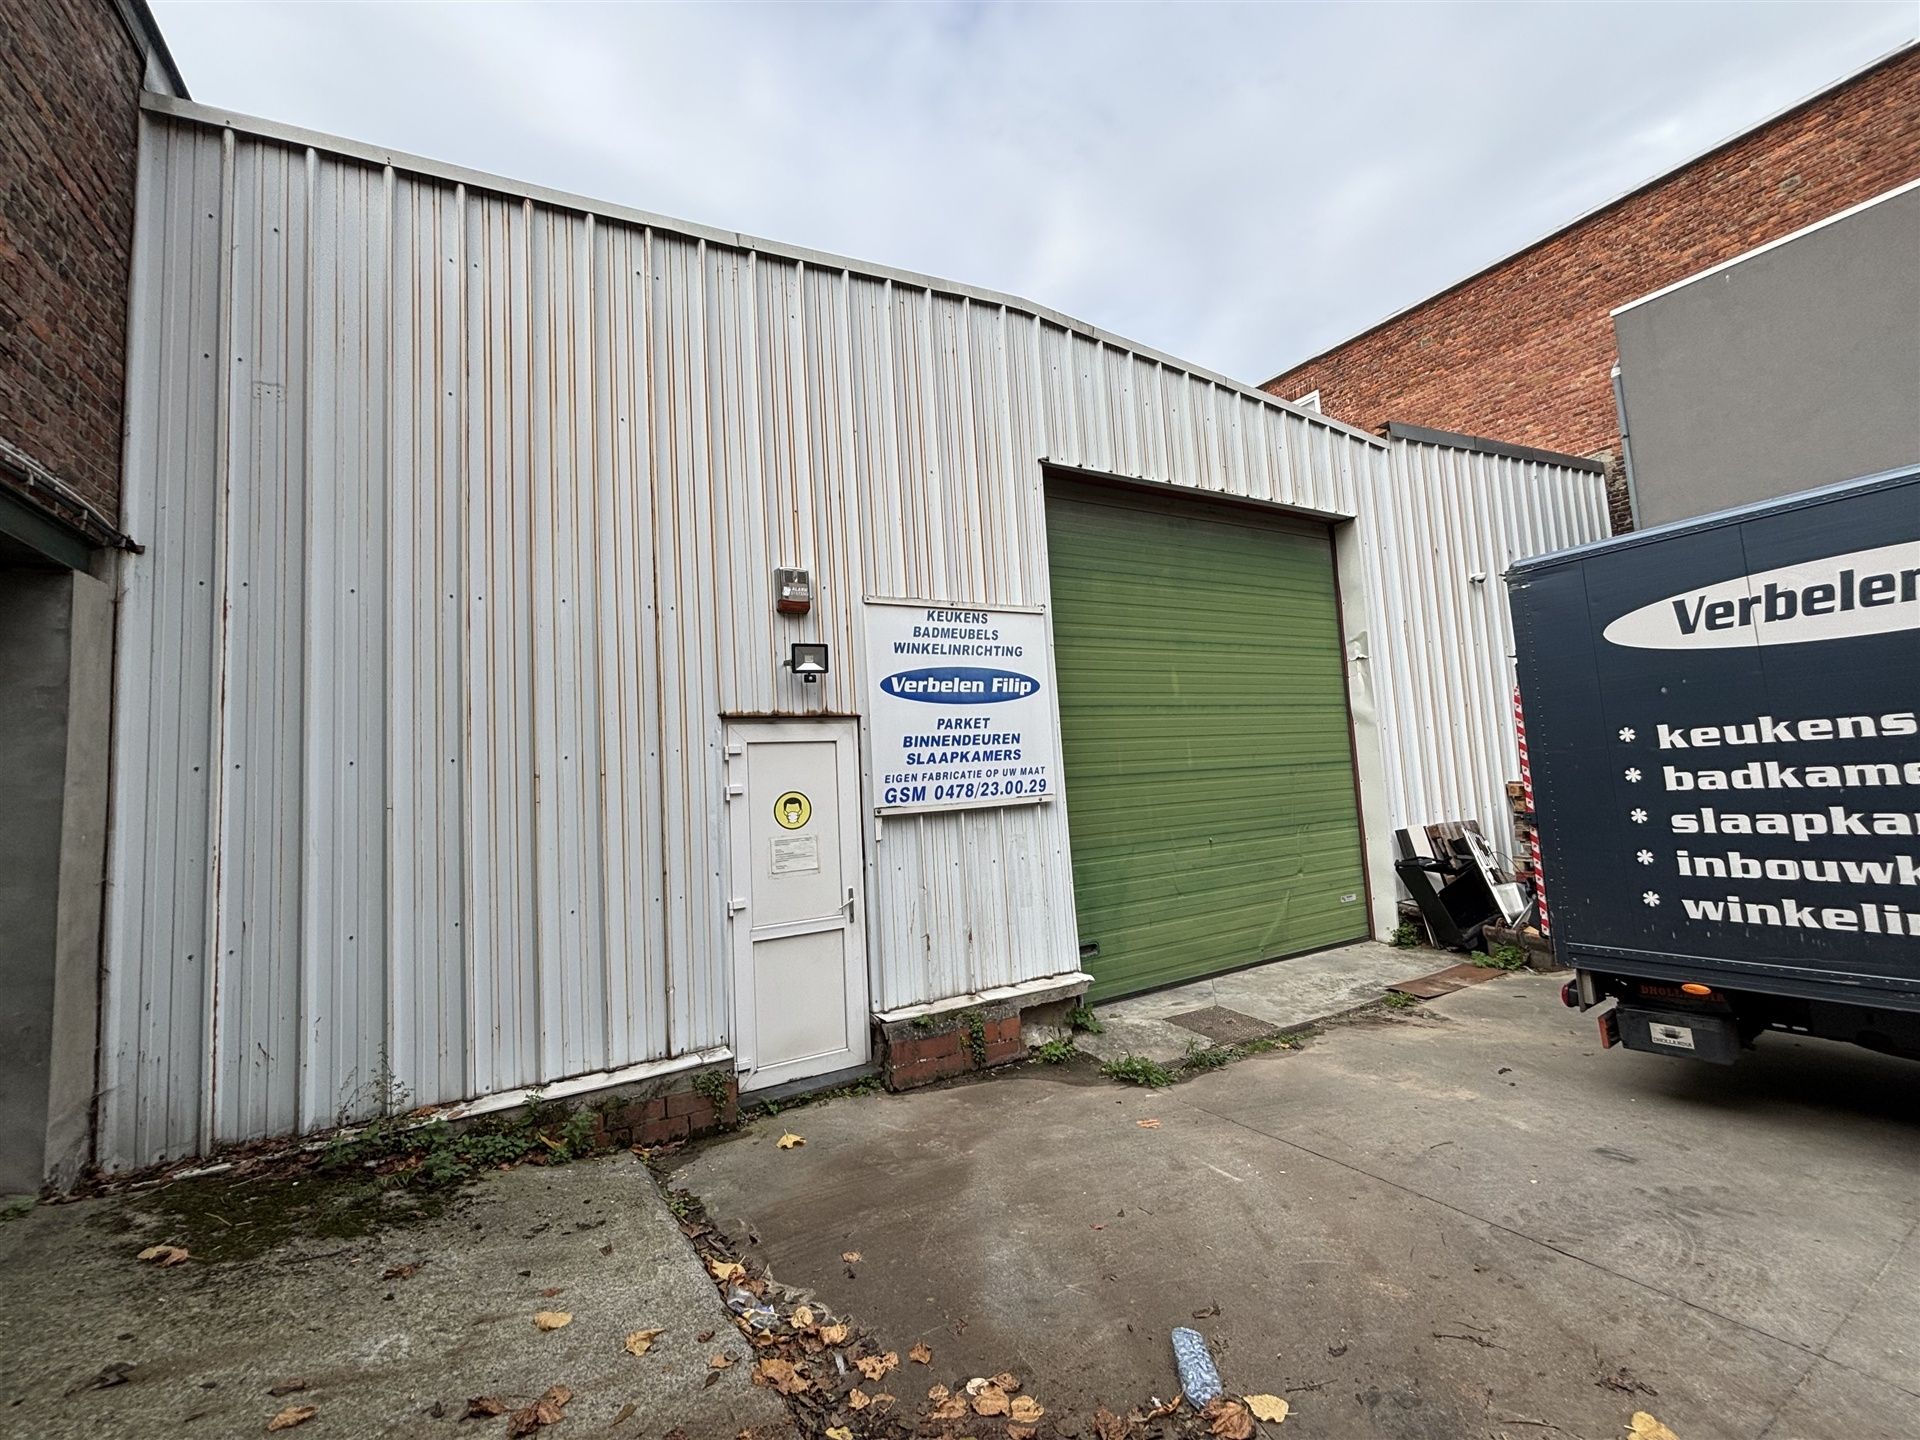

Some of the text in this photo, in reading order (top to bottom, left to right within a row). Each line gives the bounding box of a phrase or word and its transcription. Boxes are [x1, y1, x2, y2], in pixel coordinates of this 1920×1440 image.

[927, 610, 988, 624] KEUKENS
[913, 627, 999, 640] BADMEUBELS
[893, 642, 1023, 657] WINKELINRICHTING
[890, 676, 1032, 696] Verbelen Filip
[936, 718, 990, 730] PARKET
[1656, 712, 1917, 750] keukens
[903, 733, 1021, 748] BINNENDEUREN
[906, 749, 1022, 765] SLAAPKAMERS
[884, 766, 1046, 784] EIGEN FABRICATIE OP UW MAAT
[884, 778, 1047, 804] GSM 0478/23.00.29
[1672, 807, 1920, 842] slaapka
